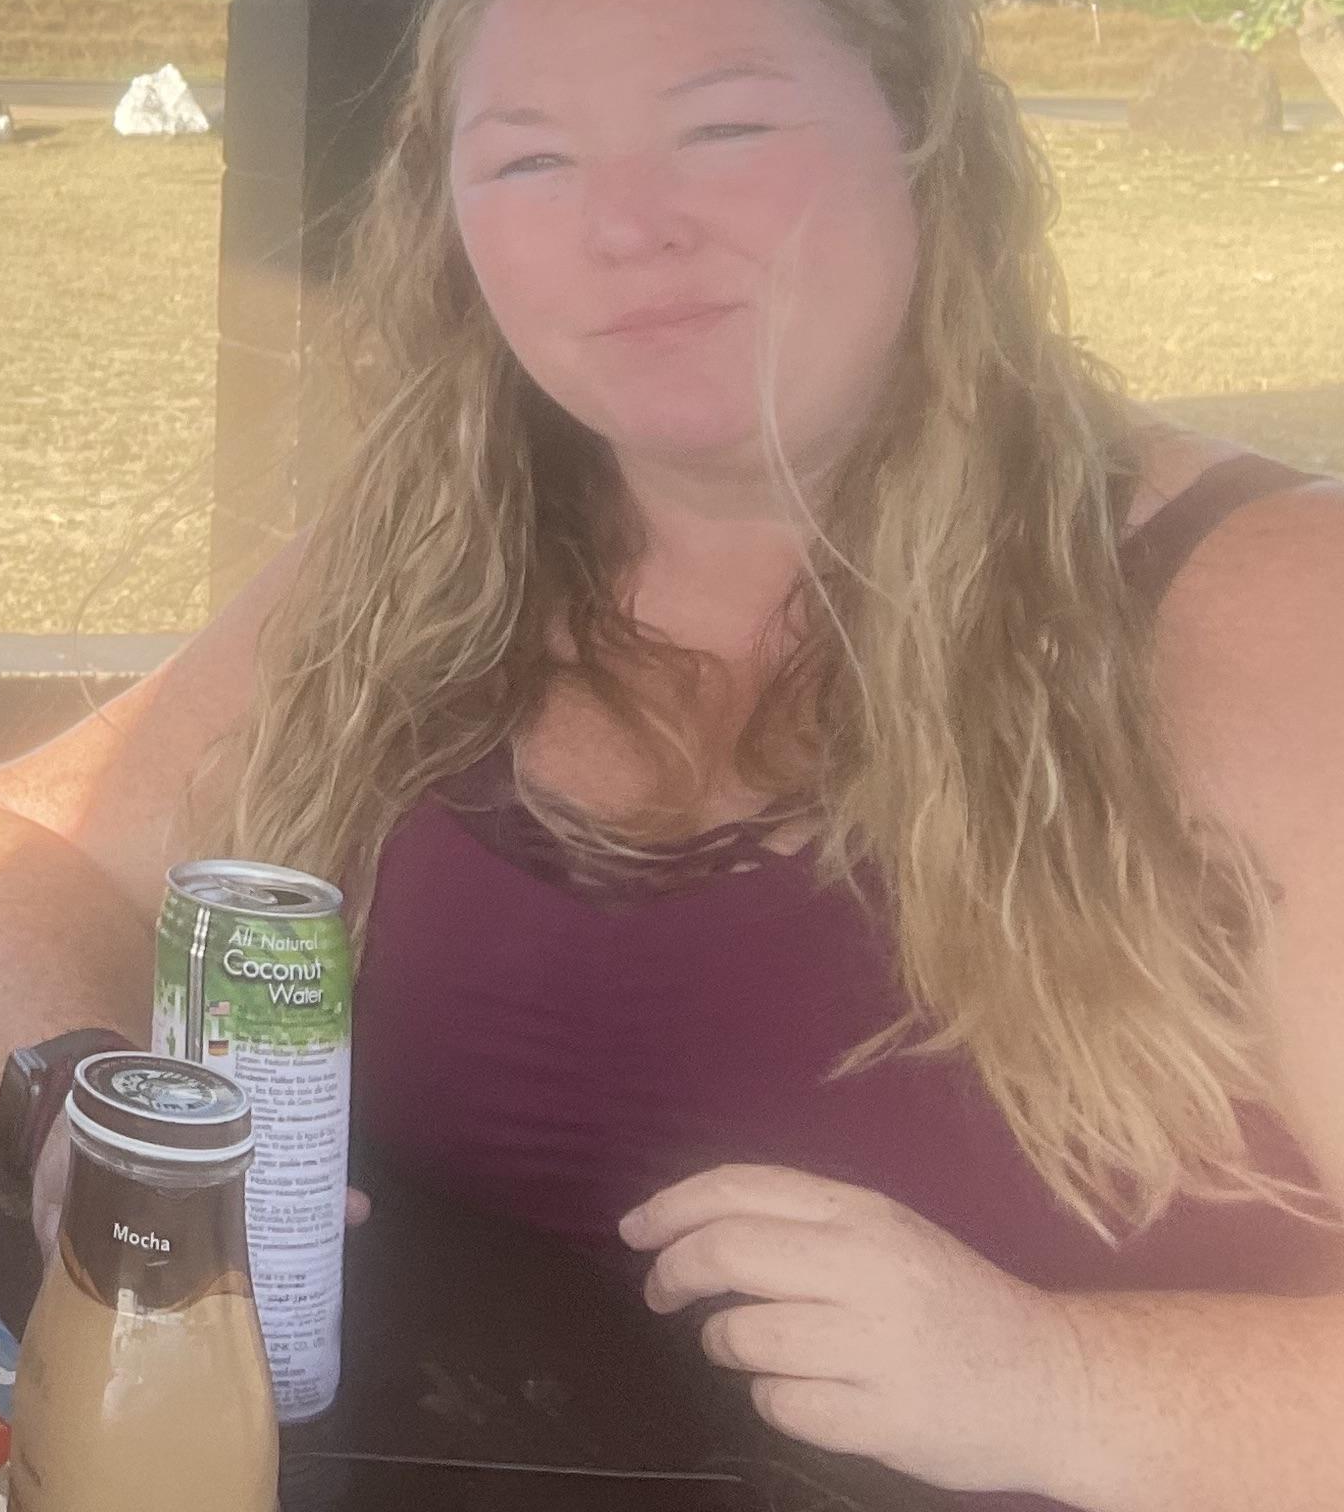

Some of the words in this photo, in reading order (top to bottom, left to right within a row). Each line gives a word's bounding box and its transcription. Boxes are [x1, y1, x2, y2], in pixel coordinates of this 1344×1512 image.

[228, 927, 254, 947] All
[261, 932, 318, 951] Natural
[224, 948, 322, 981] Coconut
[269, 982, 323, 1005] Water
[113, 1222, 170, 1252] Mocha
